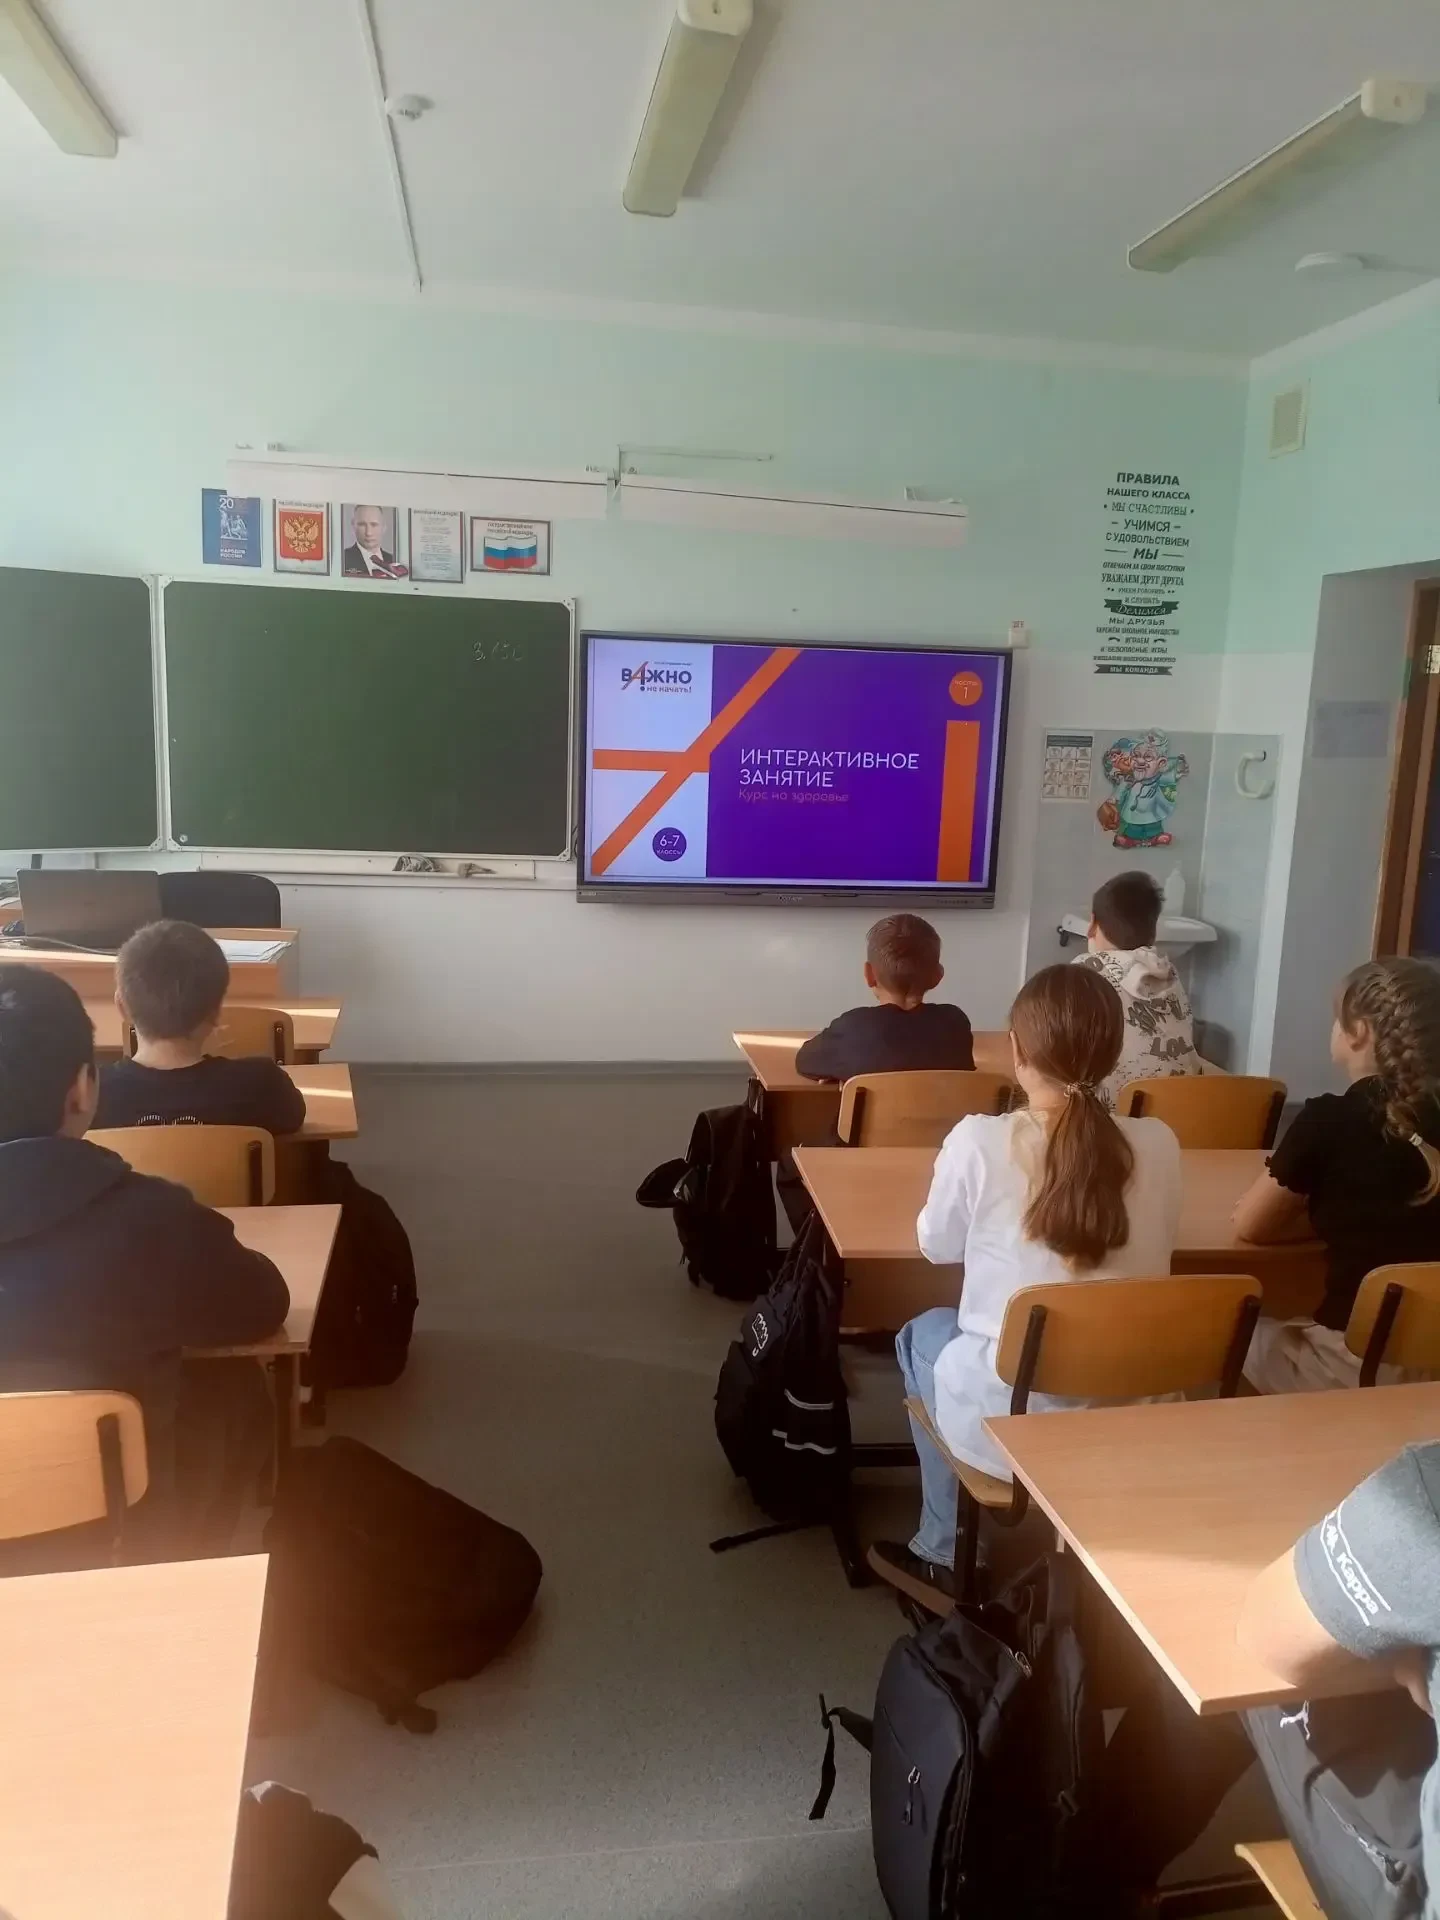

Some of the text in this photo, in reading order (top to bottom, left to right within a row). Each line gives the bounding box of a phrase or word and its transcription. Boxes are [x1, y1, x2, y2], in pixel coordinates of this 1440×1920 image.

[1116, 472, 1180, 486] ПРАВИЛА
[1106, 488, 1190, 500] НАШЕГО КЛАССА
[1111, 502, 1187, 516] МЫ СЧАСТЛИВЫ
[1124, 519, 1171, 532] УЧИМСЯ
[1105, 532, 1190, 547] С УДОВОЛЬСТВИЕМ
[1133, 548, 1159, 560] МЫ
[1101, 572, 1184, 587] УВАЖАЕМ ДРУГ ДРУГА
[1116, 604, 1167, 616] Делимся
[1109, 617, 1165, 626] МЫ ДРУЗЬЯ
[1125, 666, 1159, 674] КОМАНДА
[963, 686, 968, 699] 1
[741, 749, 920, 770] ИНТЕРАКТИВНОЕ
[739, 768, 834, 788] ЗАНЯТИЕ
[738, 788, 849, 804] Курс на здоровье
[660, 834, 681, 847] 6-7
[1336, 1552, 1379, 1615] Kappa
